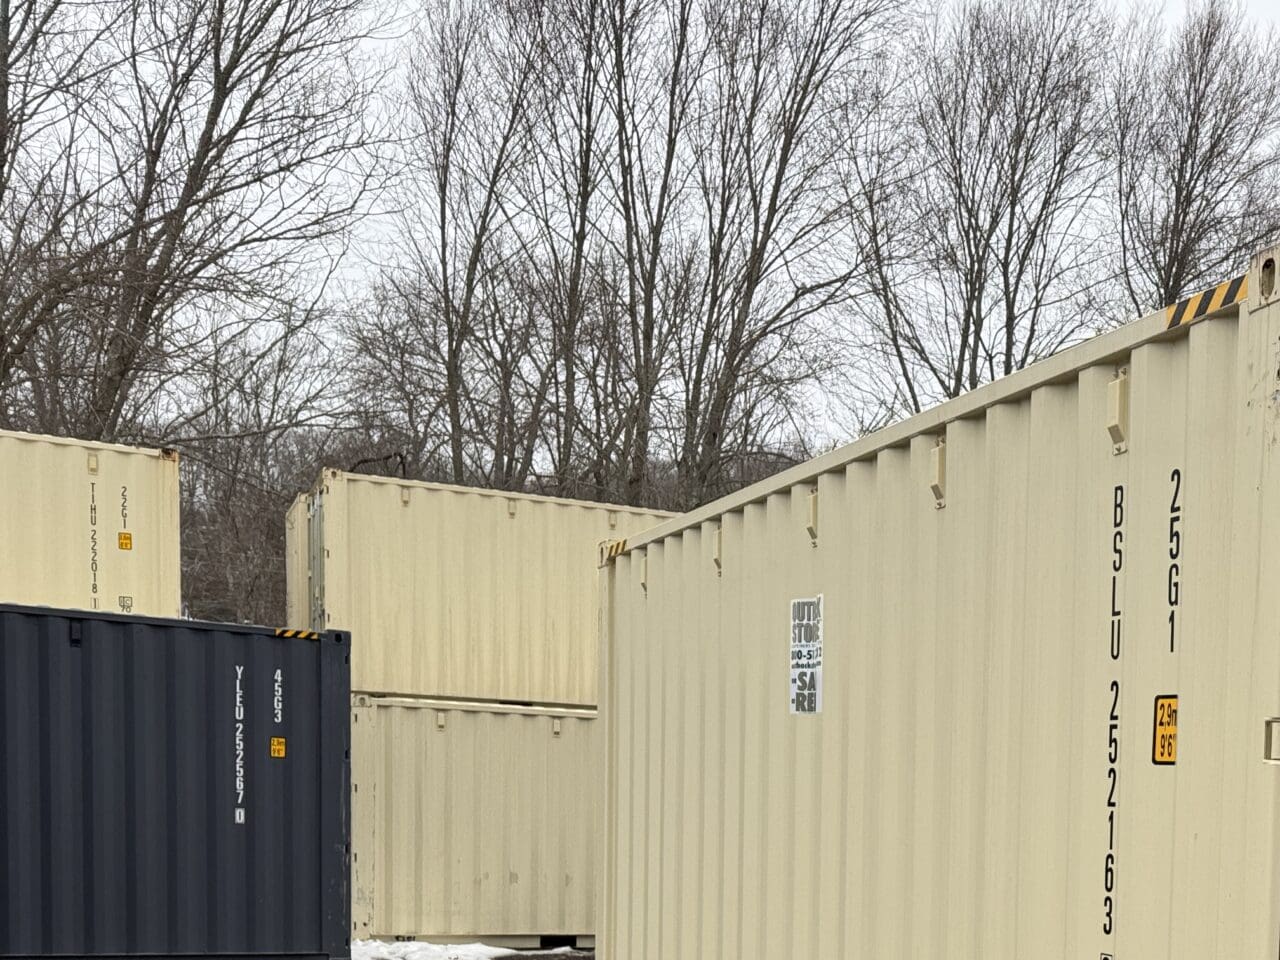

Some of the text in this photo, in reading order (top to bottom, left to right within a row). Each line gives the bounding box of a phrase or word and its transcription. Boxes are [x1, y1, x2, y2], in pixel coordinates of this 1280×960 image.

[1110, 485, 1125, 661] BSLU
[1168, 468, 1182, 653] 25G1
[235, 665, 244, 720] YLEU
[274, 669, 282, 723] 45G3
[797, 671, 816, 691] SA
[235, 723, 244, 804] 252567
[1102, 680, 1120, 936] 252163
